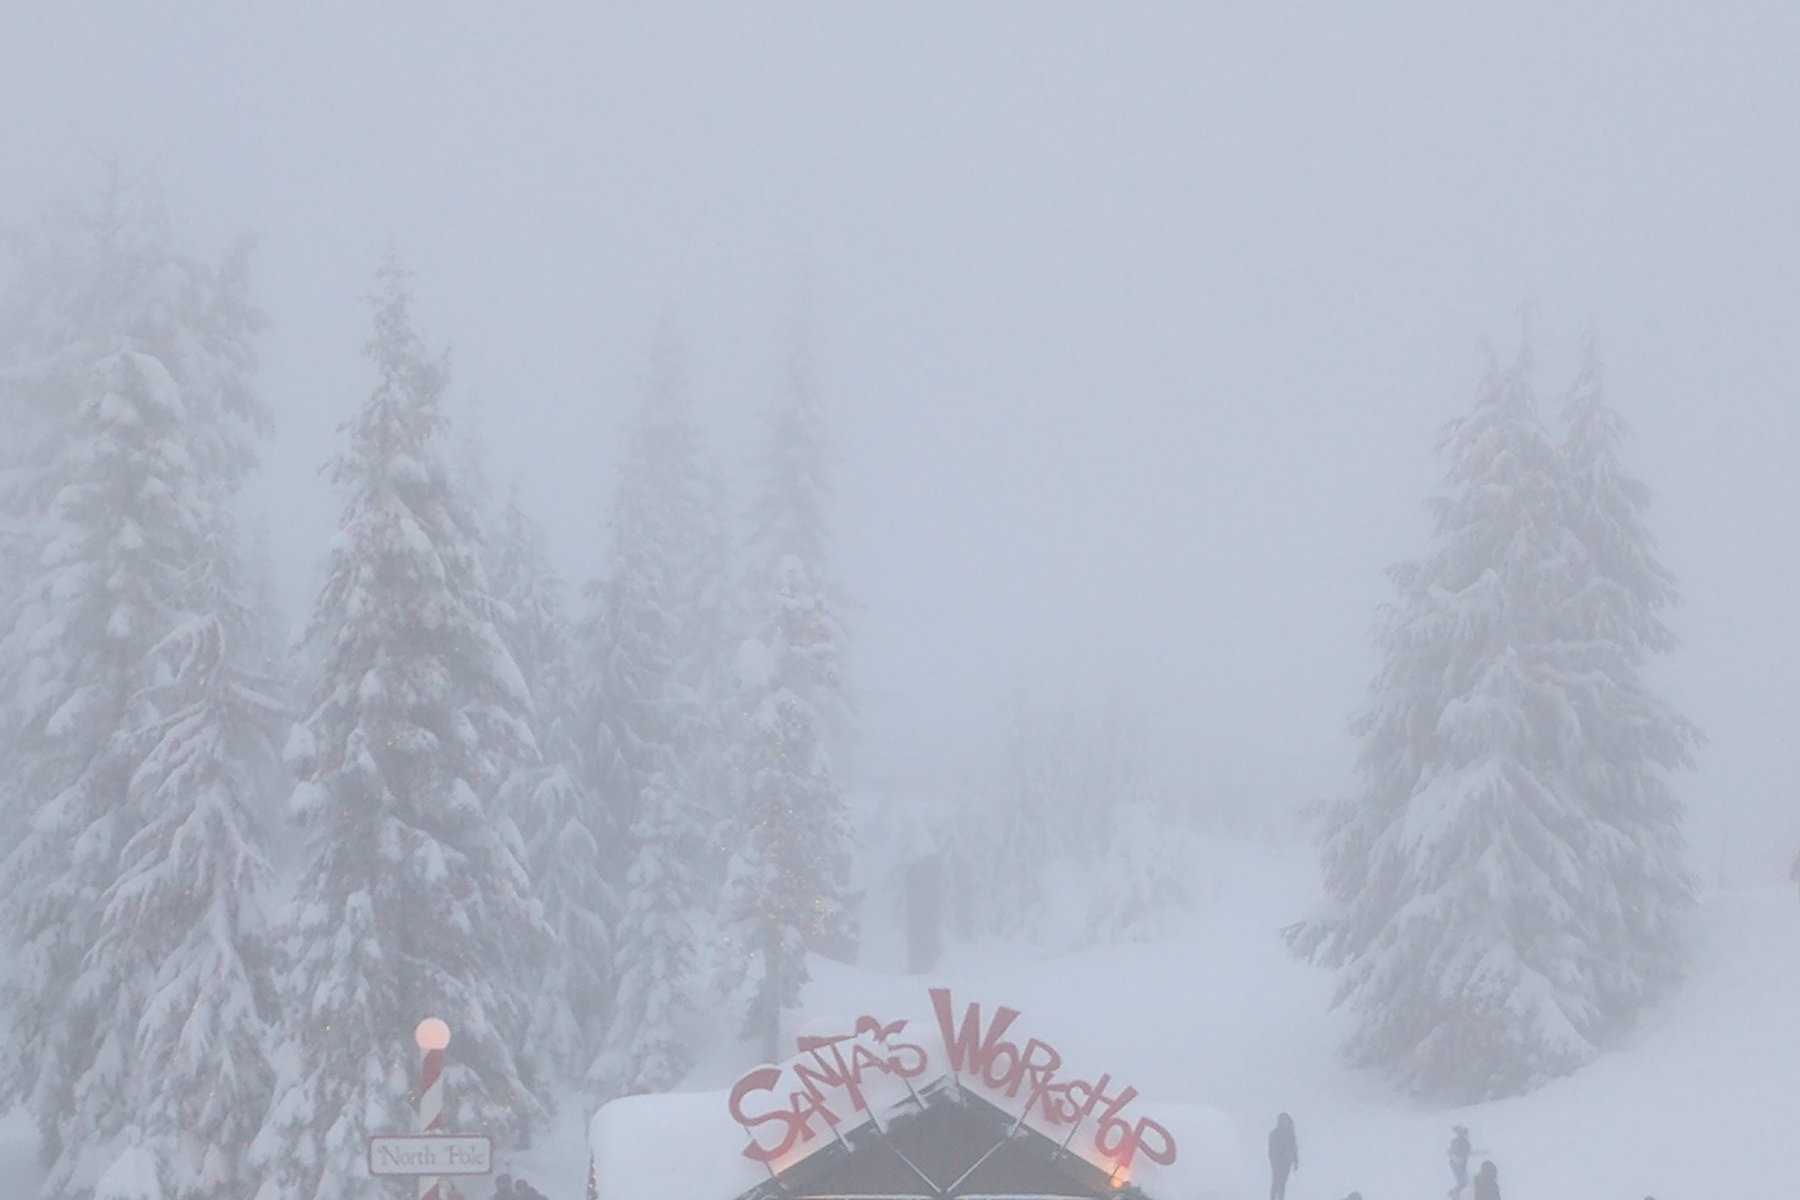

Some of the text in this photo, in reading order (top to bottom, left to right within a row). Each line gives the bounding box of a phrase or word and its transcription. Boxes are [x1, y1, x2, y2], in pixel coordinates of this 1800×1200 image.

[728, 988, 1177, 1167] SANTA'S WORKSHOP
[378, 1144, 483, 1165] North Pole
